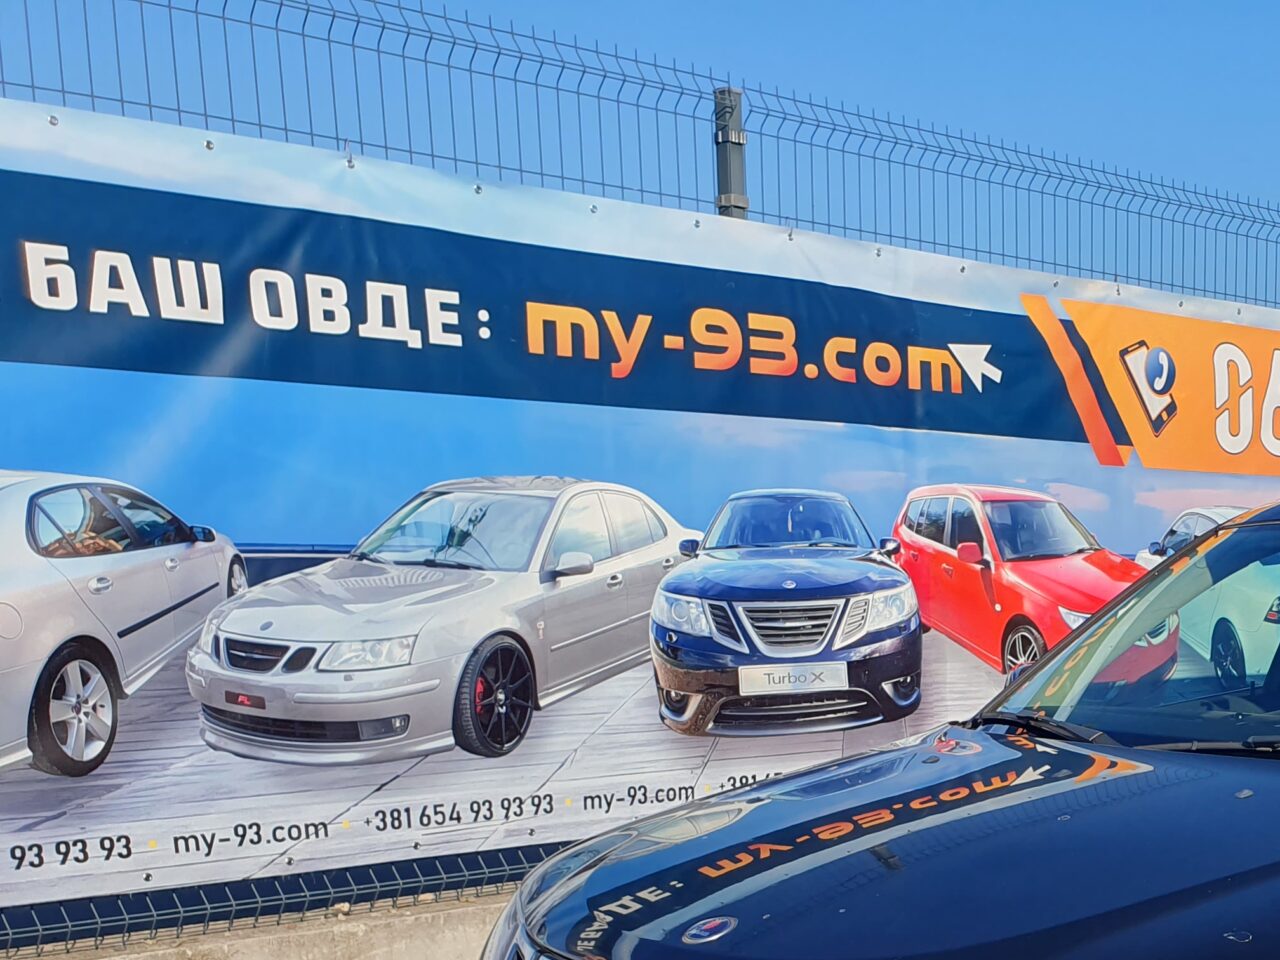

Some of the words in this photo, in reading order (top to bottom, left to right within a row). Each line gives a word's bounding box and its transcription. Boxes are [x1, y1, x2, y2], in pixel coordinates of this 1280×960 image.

[23, 241, 225, 325] БАШ
[249, 267, 492, 349] ОВДЕ:
[525, 301, 963, 394] my-93.com
[763, 671, 807, 686] Turbo
[809, 671, 826, 684] X
[9, 843, 45, 870] 93
[54, 838, 89, 865] 93
[99, 834, 132, 861] 93
[173, 820, 330, 858] my-93.com
[363, 807, 413, 832] +381
[419, 802, 462, 827] 654
[469, 798, 494, 822] 93
[500, 796, 524, 820] 93
[530, 793, 555, 817] 93
[582, 783, 696, 814] my-93.com
